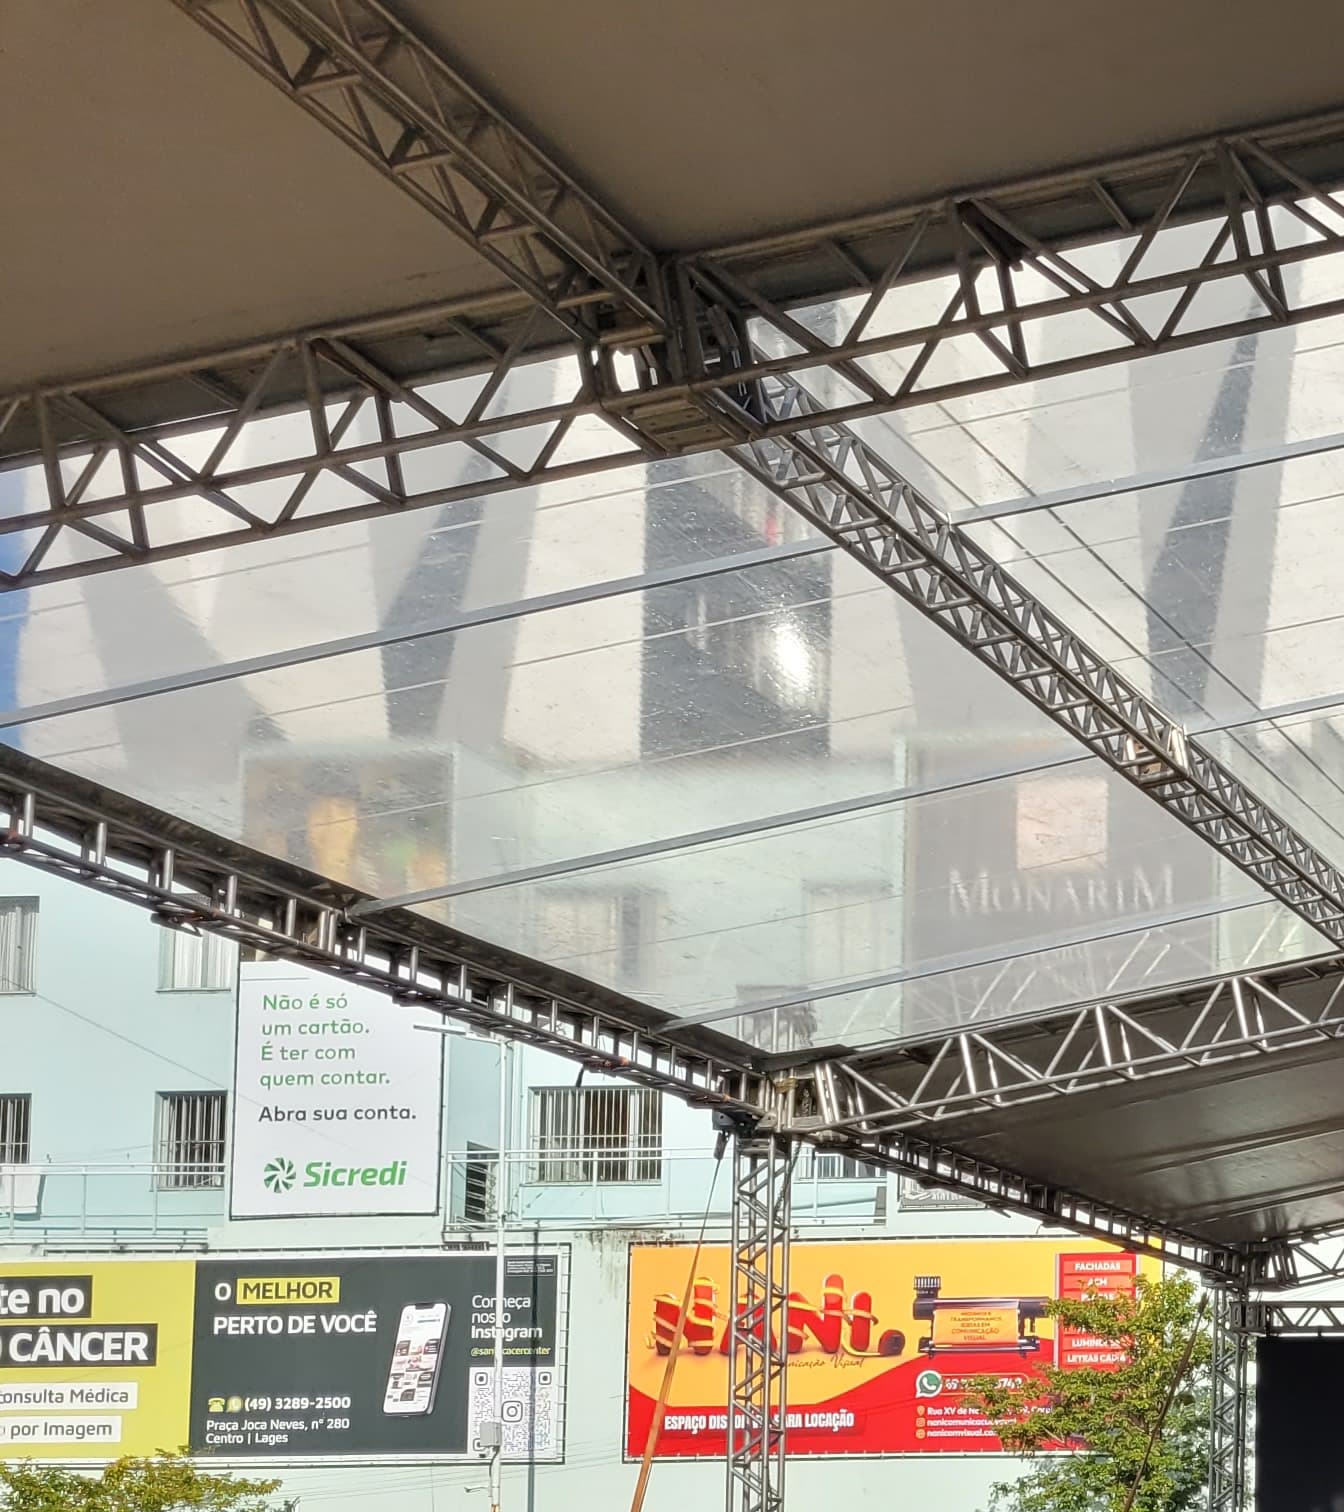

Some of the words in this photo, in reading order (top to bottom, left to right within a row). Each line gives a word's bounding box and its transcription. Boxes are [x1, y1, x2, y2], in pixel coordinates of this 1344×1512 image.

[263, 994, 302, 1010] Não
[309, 993, 320, 1009] é
[326, 993, 348, 1009] só
[262, 1023, 291, 1036] um
[298, 1019, 370, 1035] cartão.
[261, 1041, 273, 1061] É
[280, 1046, 308, 1060] ter
[315, 1047, 356, 1060] com
[260, 1073, 314, 1090] quem
[320, 1070, 390, 1085] contar.
[258, 1106, 307, 1122] Abra
[313, 1107, 348, 1120] sua
[354, 1105, 417, 1120] conta.
[303, 1160, 408, 1188] Sicredi
[1074, 1262, 1121, 1271] FACHADAS
[214, 1282, 232, 1300] O
[242, 1281, 333, 1300] MELHOR
[38, 1287, 85, 1314] no
[213, 1315, 283, 1335] PERTO
[287, 1315, 316, 1334] DE
[320, 1309, 378, 1333] VOCÊ
[471, 1312, 512, 1324] noso
[9, 1326, 149, 1362] CÂNCER
[70, 1387, 129, 1403] Médica
[244, 1397, 272, 1412] (49)
[275, 1396, 351, 1410] 3289-2500
[927, 1406, 943, 1415] Rua
[943, 1406, 956, 1415] XV
[957, 1406, 968, 1415] de
[206, 1419, 240, 1433] Praça
[241, 1419, 267, 1431] Joca
[270, 1418, 309, 1432] Neves,
[327, 1417, 350, 1430] 280
[664, 1415, 707, 1434] ESPAÇO
[804, 1409, 855, 1432] LOCAÇÃO
[11, 1423, 40, 1440] por
[44, 1421, 112, 1440] Imagem
[205, 1433, 244, 1444] Centro
[255, 1433, 289, 1446] Lages
